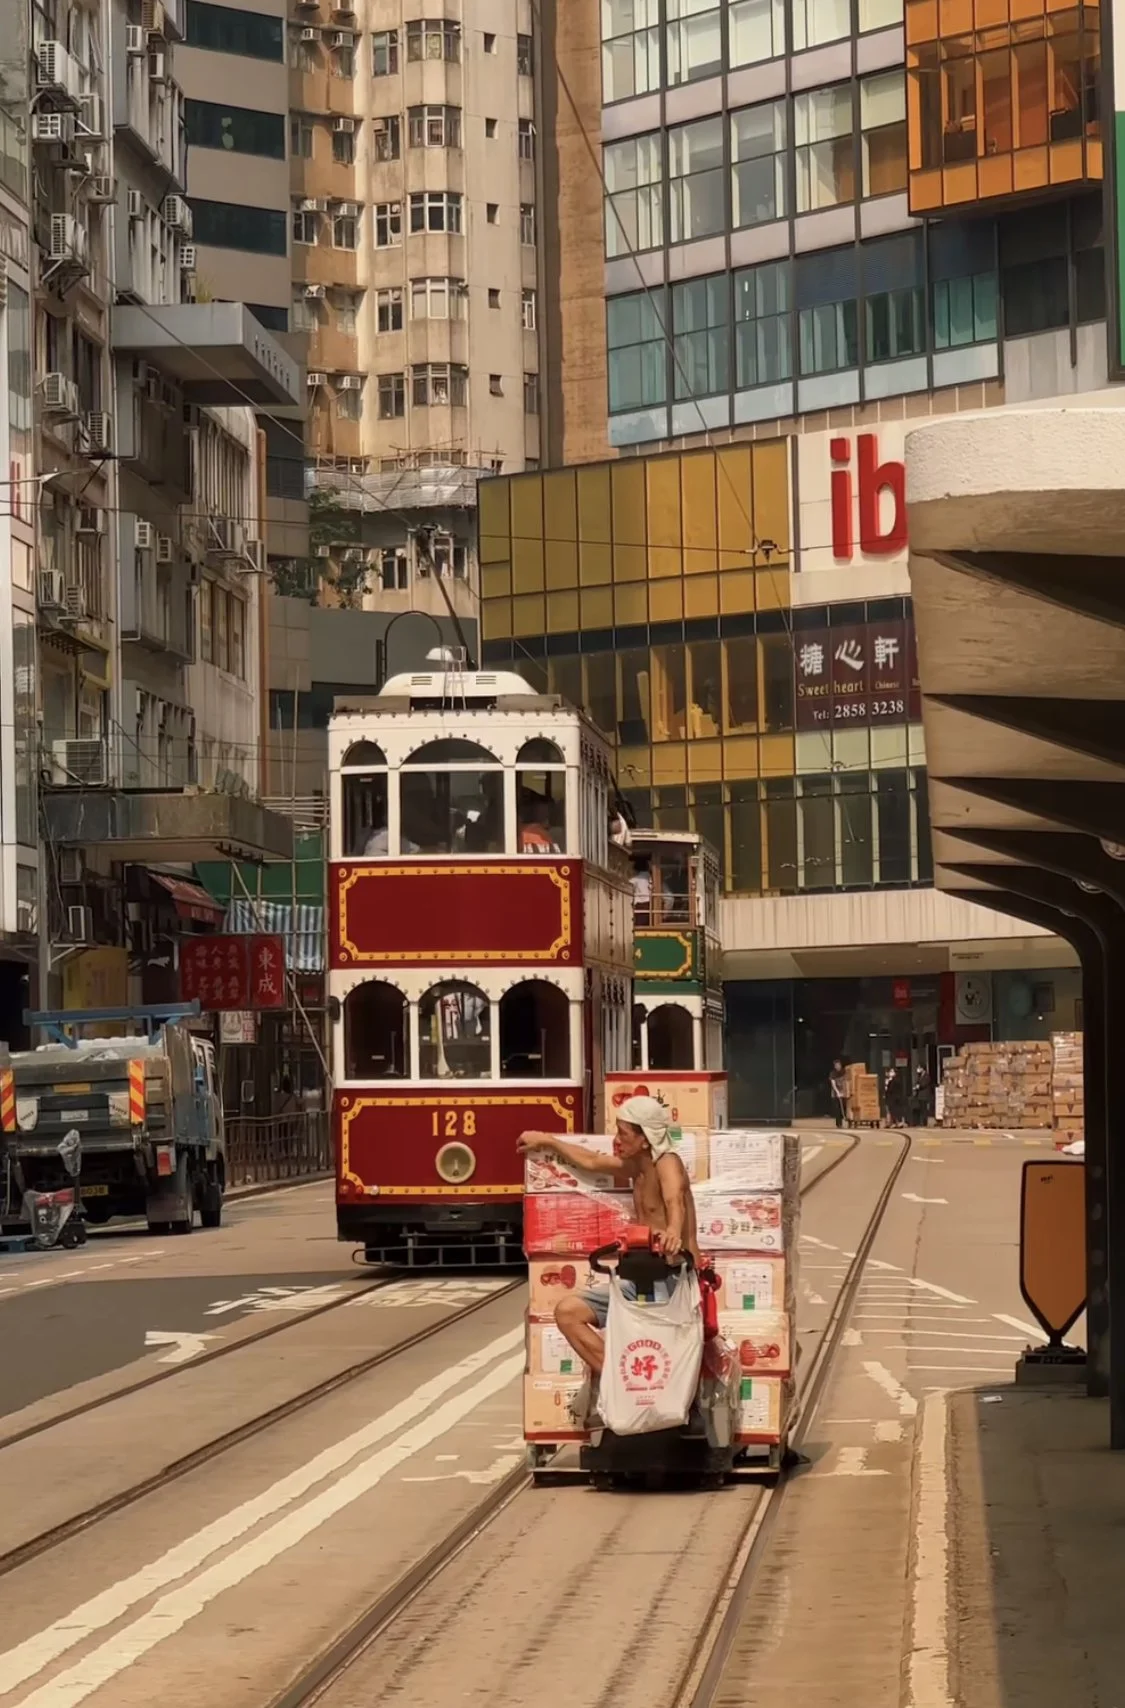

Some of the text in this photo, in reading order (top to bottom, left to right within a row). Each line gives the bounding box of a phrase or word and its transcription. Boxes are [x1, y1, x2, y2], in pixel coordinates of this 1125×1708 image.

[798, 682, 830, 697] Sweet
[834, 680, 864, 694] heart
[834, 702, 866, 719] 2858
[872, 700, 904, 715] 3238
[258, 947, 277, 994] 東成
[432, 1110, 476, 1136] 128
[627, 1339, 662, 1352] GOOD
[631, 1355, 658, 1381] 好
